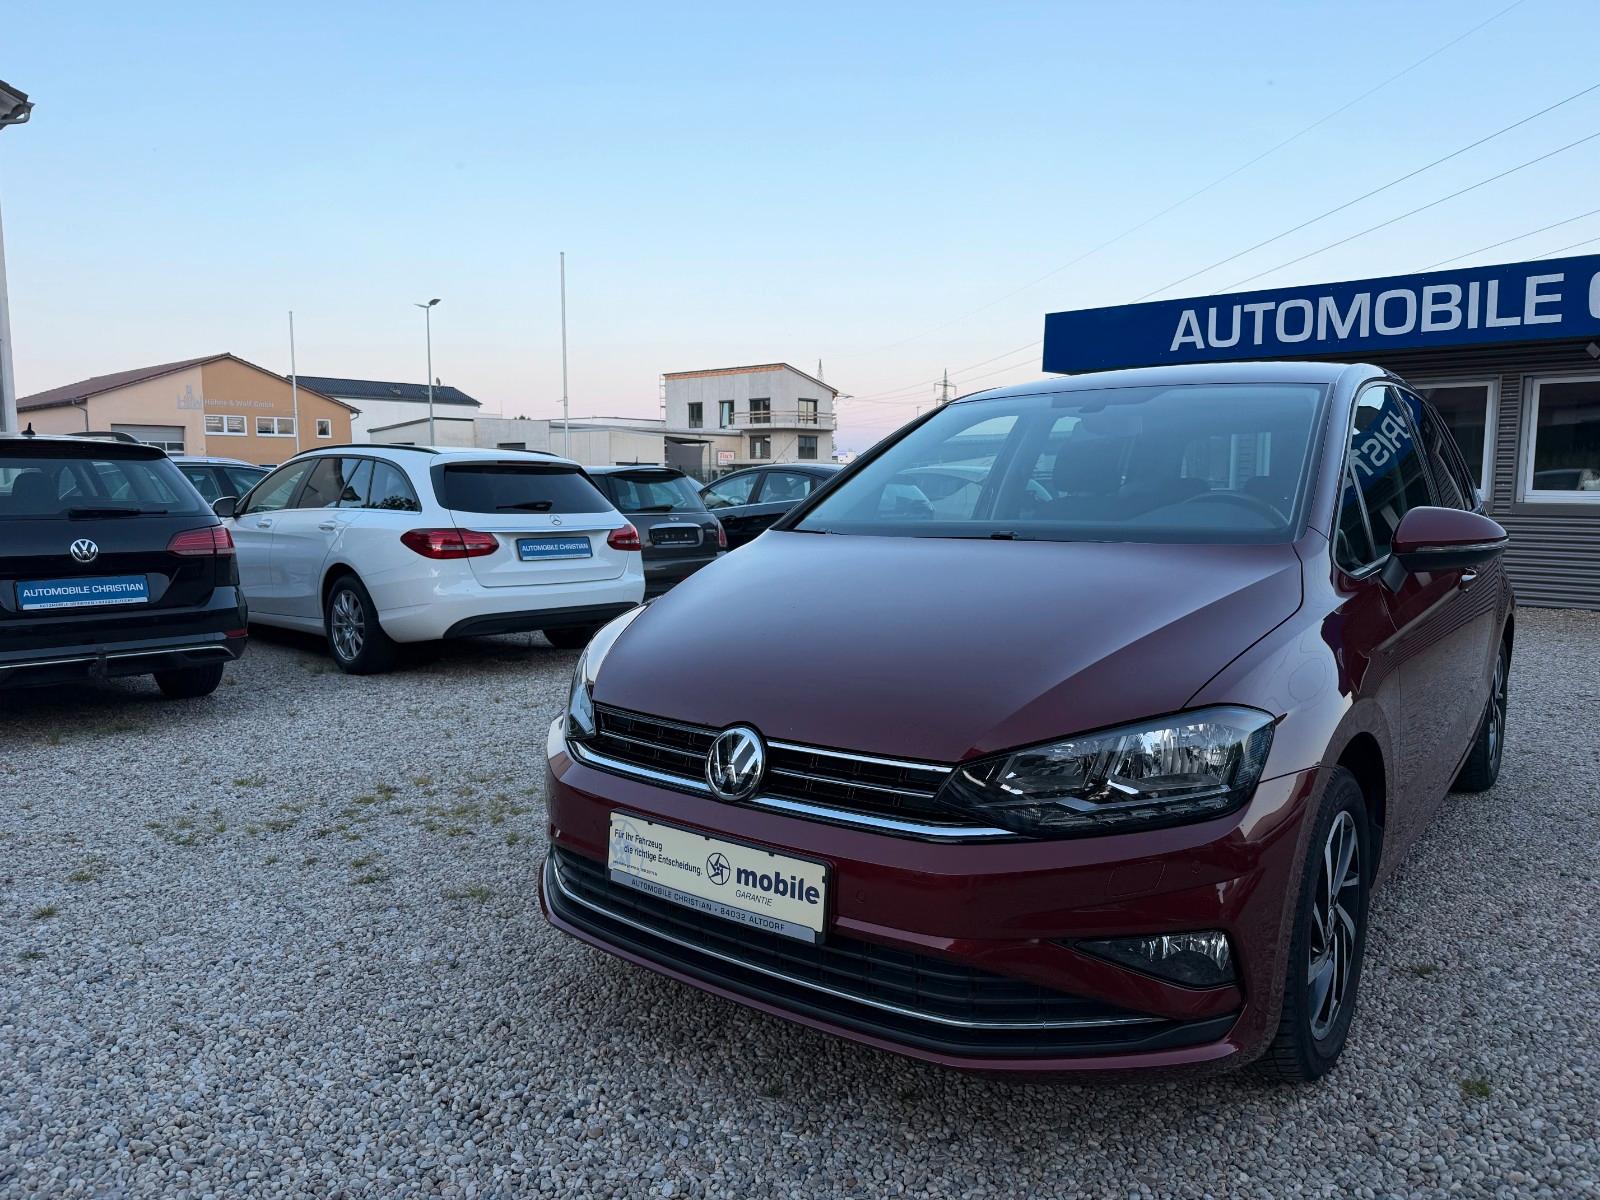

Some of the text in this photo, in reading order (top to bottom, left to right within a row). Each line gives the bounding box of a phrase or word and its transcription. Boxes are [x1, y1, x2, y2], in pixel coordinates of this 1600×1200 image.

[1169, 272, 1565, 352] AUTOMOBILE
[522, 544, 559, 552] AUTOMOBILE
[23, 583, 144, 597] AUTOMOBILE CHRISTIAN
[614, 829, 663, 852] Für Ihr Fahrzeug
[624, 845, 633, 855] die
[634, 848, 657, 863] richtige
[657, 854, 703, 876] Entscheidung.
[735, 889, 773, 907] GARANTIE
[736, 866, 821, 905] mobile
[631, 878, 785, 932] AUTOMOBILE CHRISTIAN 84032 ALTDORF
